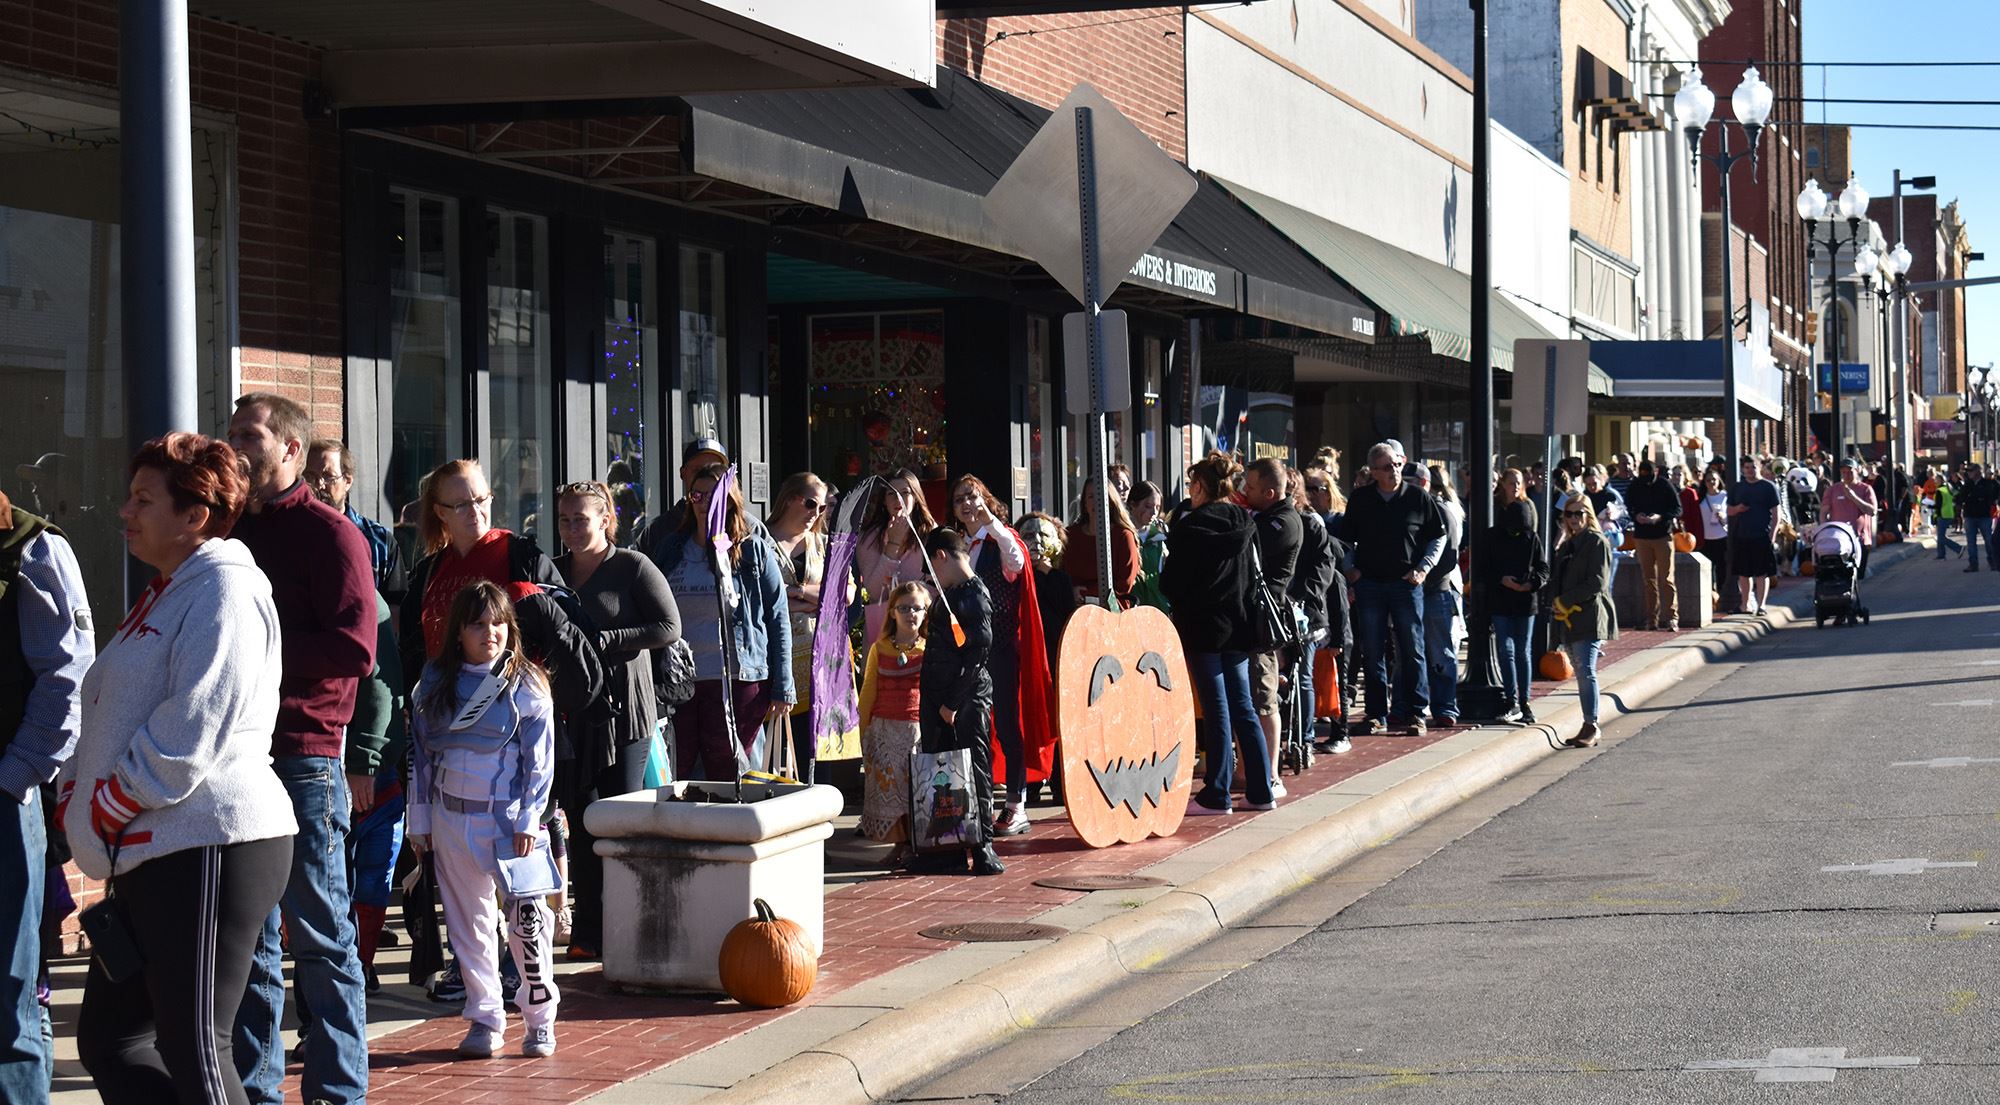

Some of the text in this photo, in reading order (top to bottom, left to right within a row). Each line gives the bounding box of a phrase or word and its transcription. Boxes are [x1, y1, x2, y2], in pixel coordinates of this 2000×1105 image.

[1129, 253, 1216, 296] OWERS & INTERIORS
